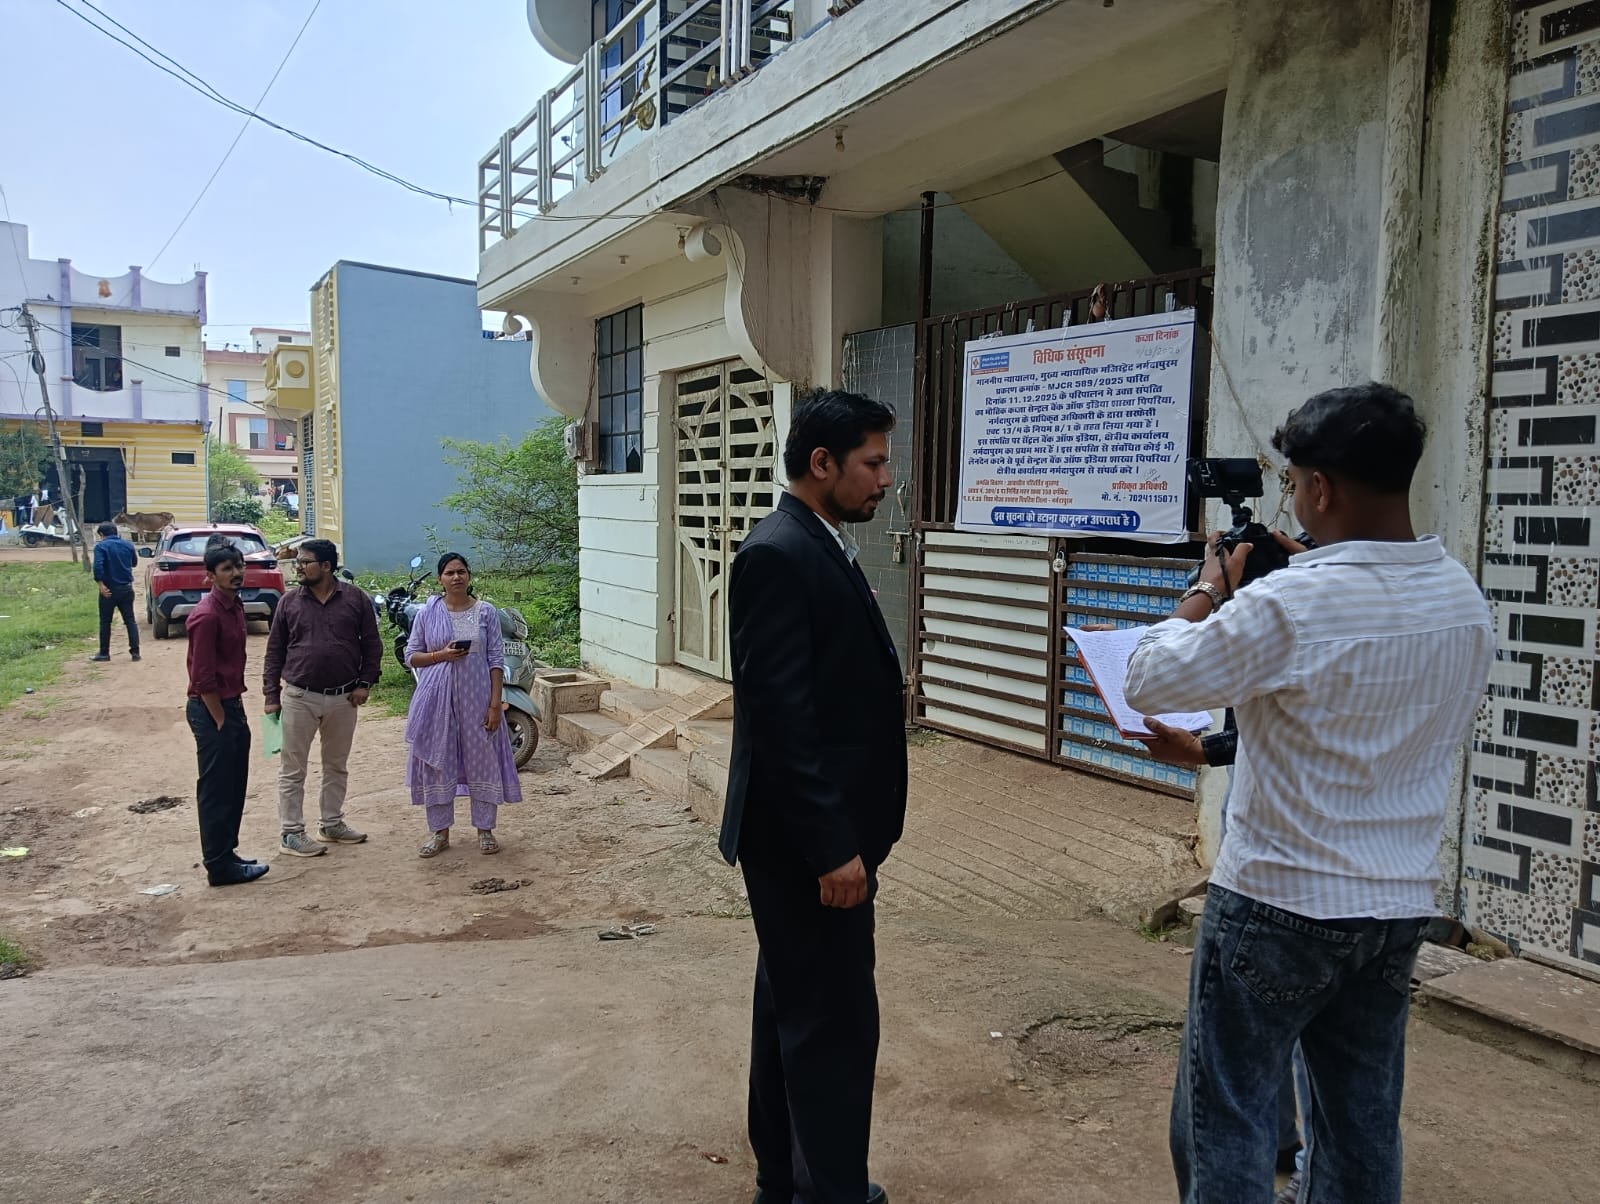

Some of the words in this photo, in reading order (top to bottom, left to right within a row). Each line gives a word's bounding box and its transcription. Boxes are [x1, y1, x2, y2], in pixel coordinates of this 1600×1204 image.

[1155, 328, 1179, 340] दिनांक
[1033, 348, 1064, 365] विधिक
[1067, 344, 1106, 364] संसूचना
[1136, 359, 1178, 370] नर्मदापुरम
[1048, 381, 1073, 390] MJCR
[1126, 373, 1150, 383] पारित
[1059, 391, 1067, 400] के
[1069, 389, 1104, 399] परिपालन
[1111, 398, 1135, 407] शाखा
[988, 416, 1020, 426] नर्मदापुरम
[1021, 414, 1029, 423] के
[1061, 411, 1095, 421] अधिकारी
[1096, 410, 1104, 419] के
[1023, 425, 1031, 433] के
[1032, 424, 1052, 433] नियम
[1073, 423, 1081, 431] के
[1083, 423, 1100, 431] तहत
[1102, 420, 1123, 430] लिया
[1126, 421, 1143, 429] गया
[977, 438, 987, 446] इस
[1131, 430, 1169, 440] कार्यालय
[973, 447, 1003, 456] नर्मदापुरम
[1005, 447, 1014, 455] का
[1034, 446, 1046, 454] भार
[1061, 445, 1072, 454] इस
[1101, 442, 1109, 452] से
[1143, 441, 1161, 452] कोई
[1164, 441, 1175, 451] भी
[968, 456, 989, 465] लेनदेन
[990, 456, 1005, 465] करने
[1007, 456, 1013, 465] से
[1014, 456, 1025, 466] पूर्व
[1109, 455, 1133, 463] शाखा
[1136, 453, 1171, 463] पिपरिया
[1017, 466, 1048, 475] कार्यालय
[1049, 466, 1085, 477] नर्मदापुरम
[1088, 465, 1095, 474] से
[1097, 465, 1117, 474] संपर्क
[1111, 481, 1137, 492] प्राधिकृत
[1139, 480, 1168, 491] अधिकारी
[994, 511, 1005, 522] इस
[1006, 512, 1025, 525] सूचना
[1025, 510, 1036, 522] को
[1037, 512, 1058, 523] हटाना
[1059, 514, 1089, 528] कानूनन
[1090, 514, 1121, 525] अपराध
[1121, 513, 1130, 526] है
